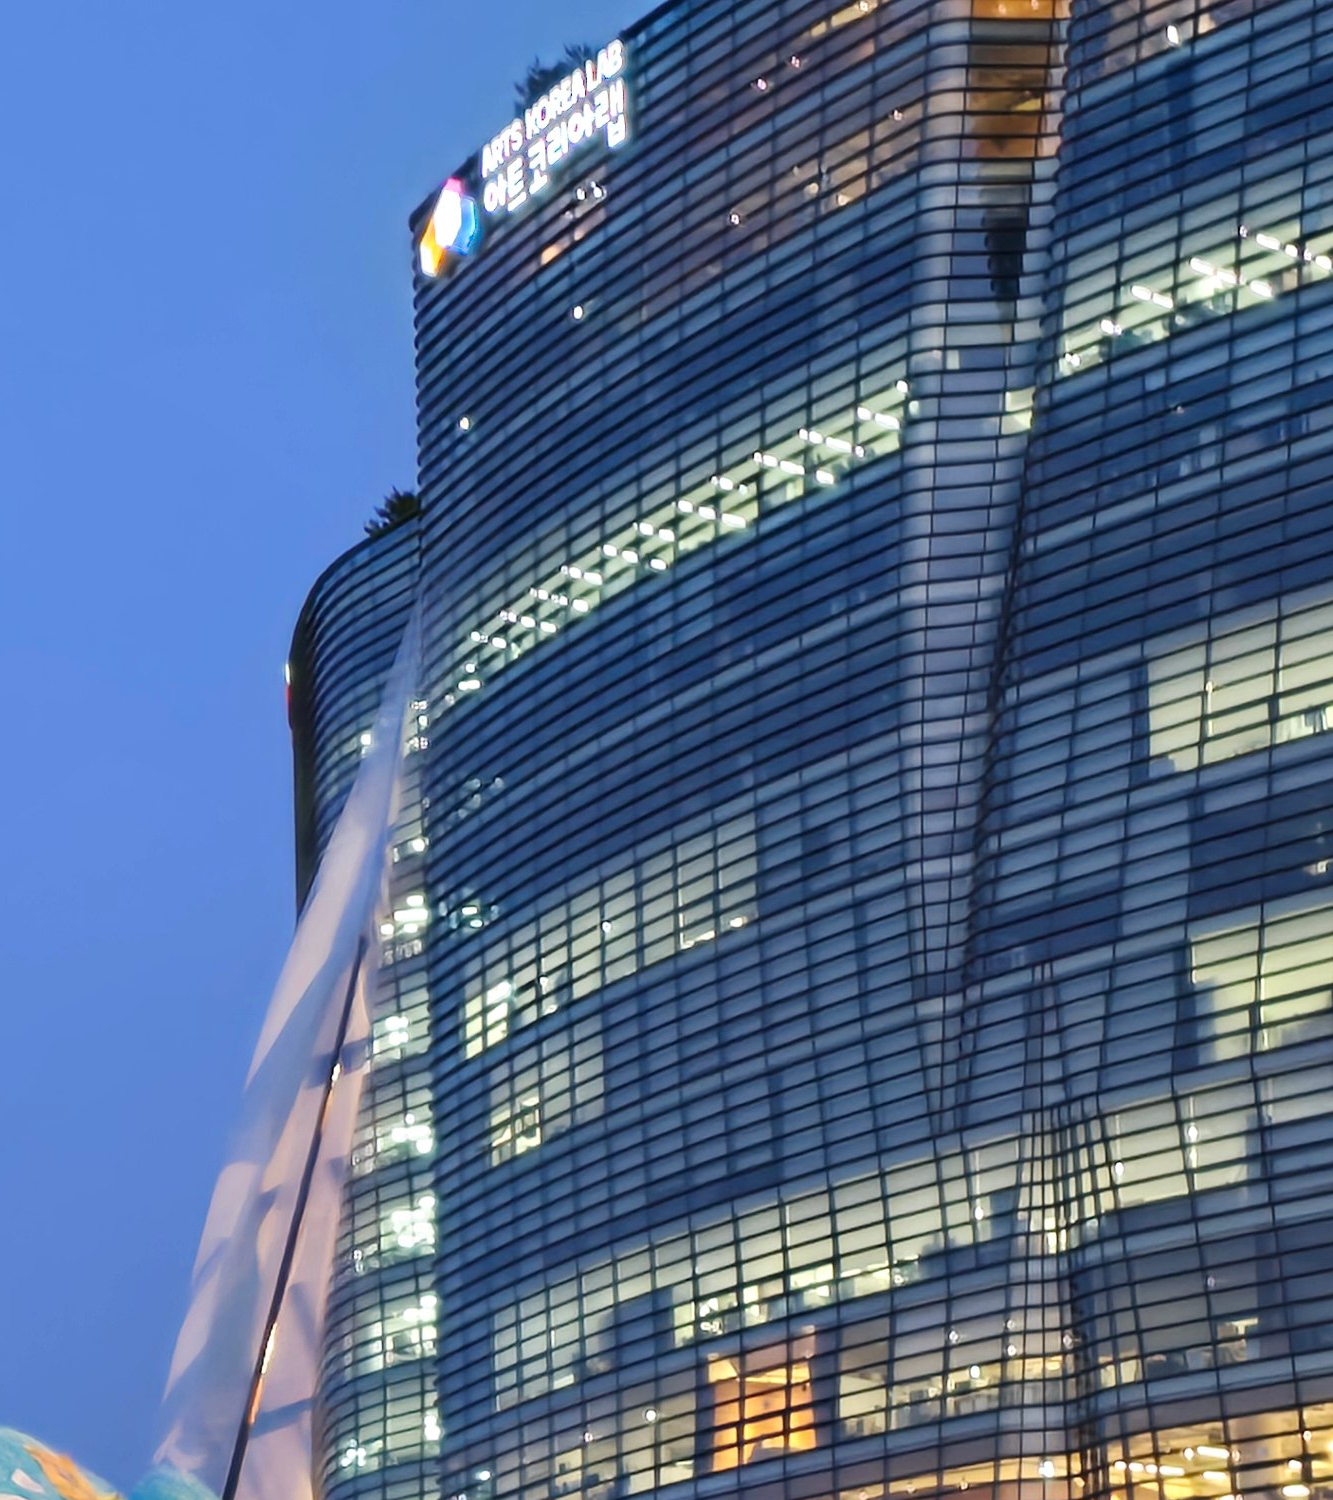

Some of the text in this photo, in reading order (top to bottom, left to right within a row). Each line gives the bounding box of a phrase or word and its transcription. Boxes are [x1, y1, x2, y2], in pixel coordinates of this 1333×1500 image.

[482, 38, 625, 178] ARTS KOREA LAB
[483, 77, 627, 213] 아트코리아랩
